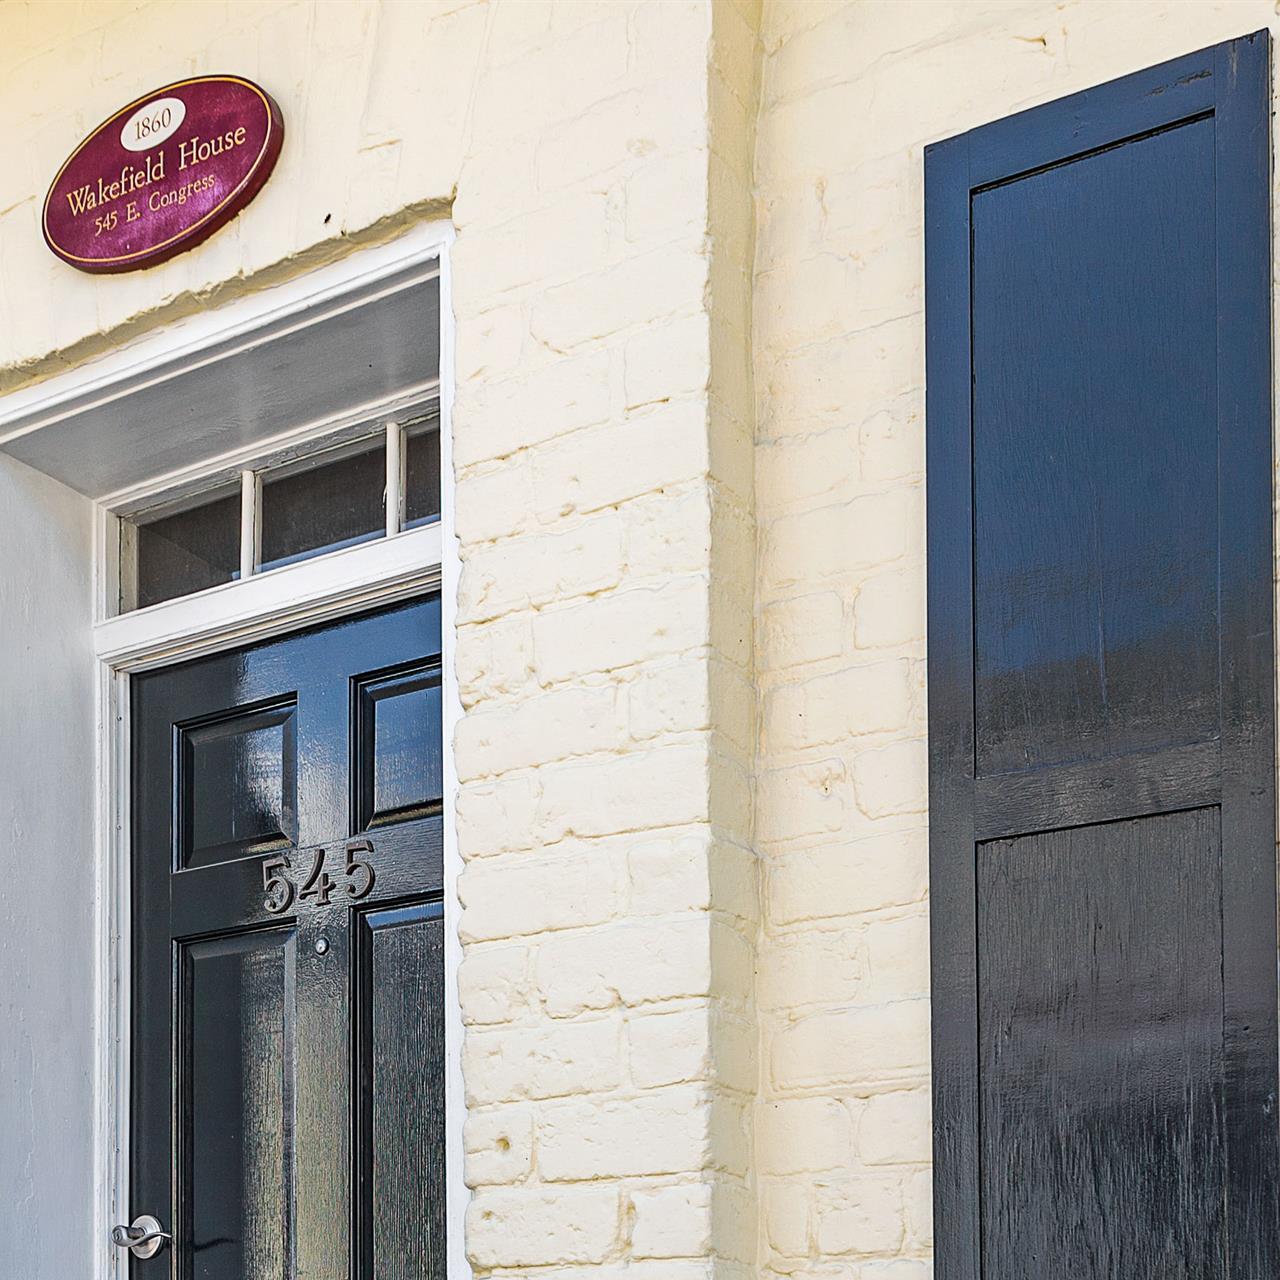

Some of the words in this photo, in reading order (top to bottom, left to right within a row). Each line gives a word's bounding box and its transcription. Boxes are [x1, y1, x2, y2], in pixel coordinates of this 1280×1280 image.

[134, 107, 172, 141] 1860
[66, 150, 166, 217] Wakefield
[178, 126, 247, 171] House
[95, 210, 118, 236] 545
[126, 203, 142, 222] E.
[149, 174, 216, 212] Congress
[262, 840, 376, 914] 545
